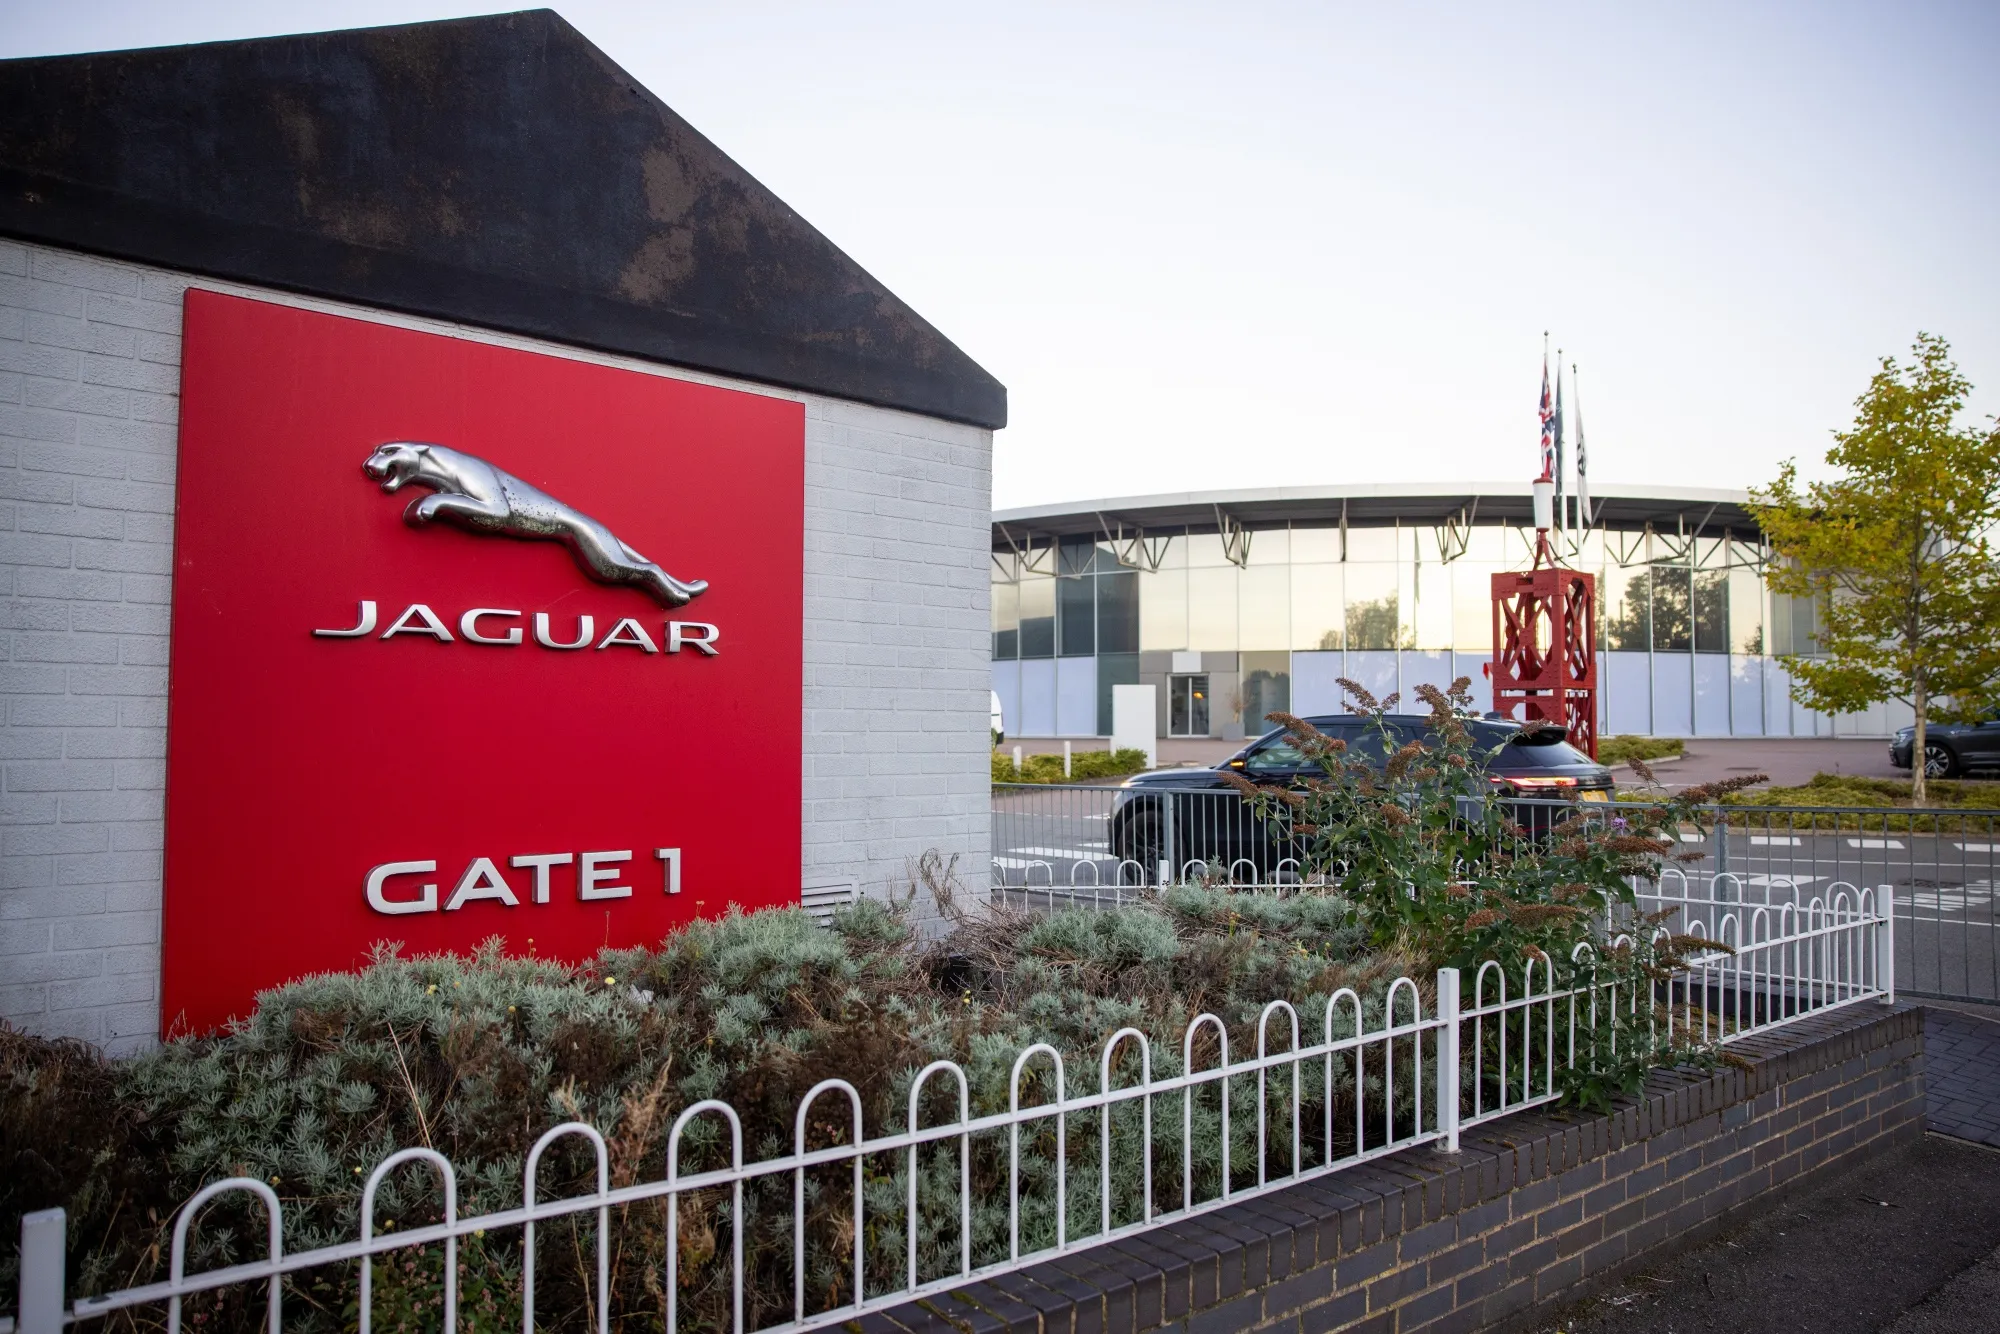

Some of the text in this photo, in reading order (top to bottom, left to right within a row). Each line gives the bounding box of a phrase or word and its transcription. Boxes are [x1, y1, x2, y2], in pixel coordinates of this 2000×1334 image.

[313, 600, 721, 655] JAGUAR
[364, 846, 682, 914] GATE 1
